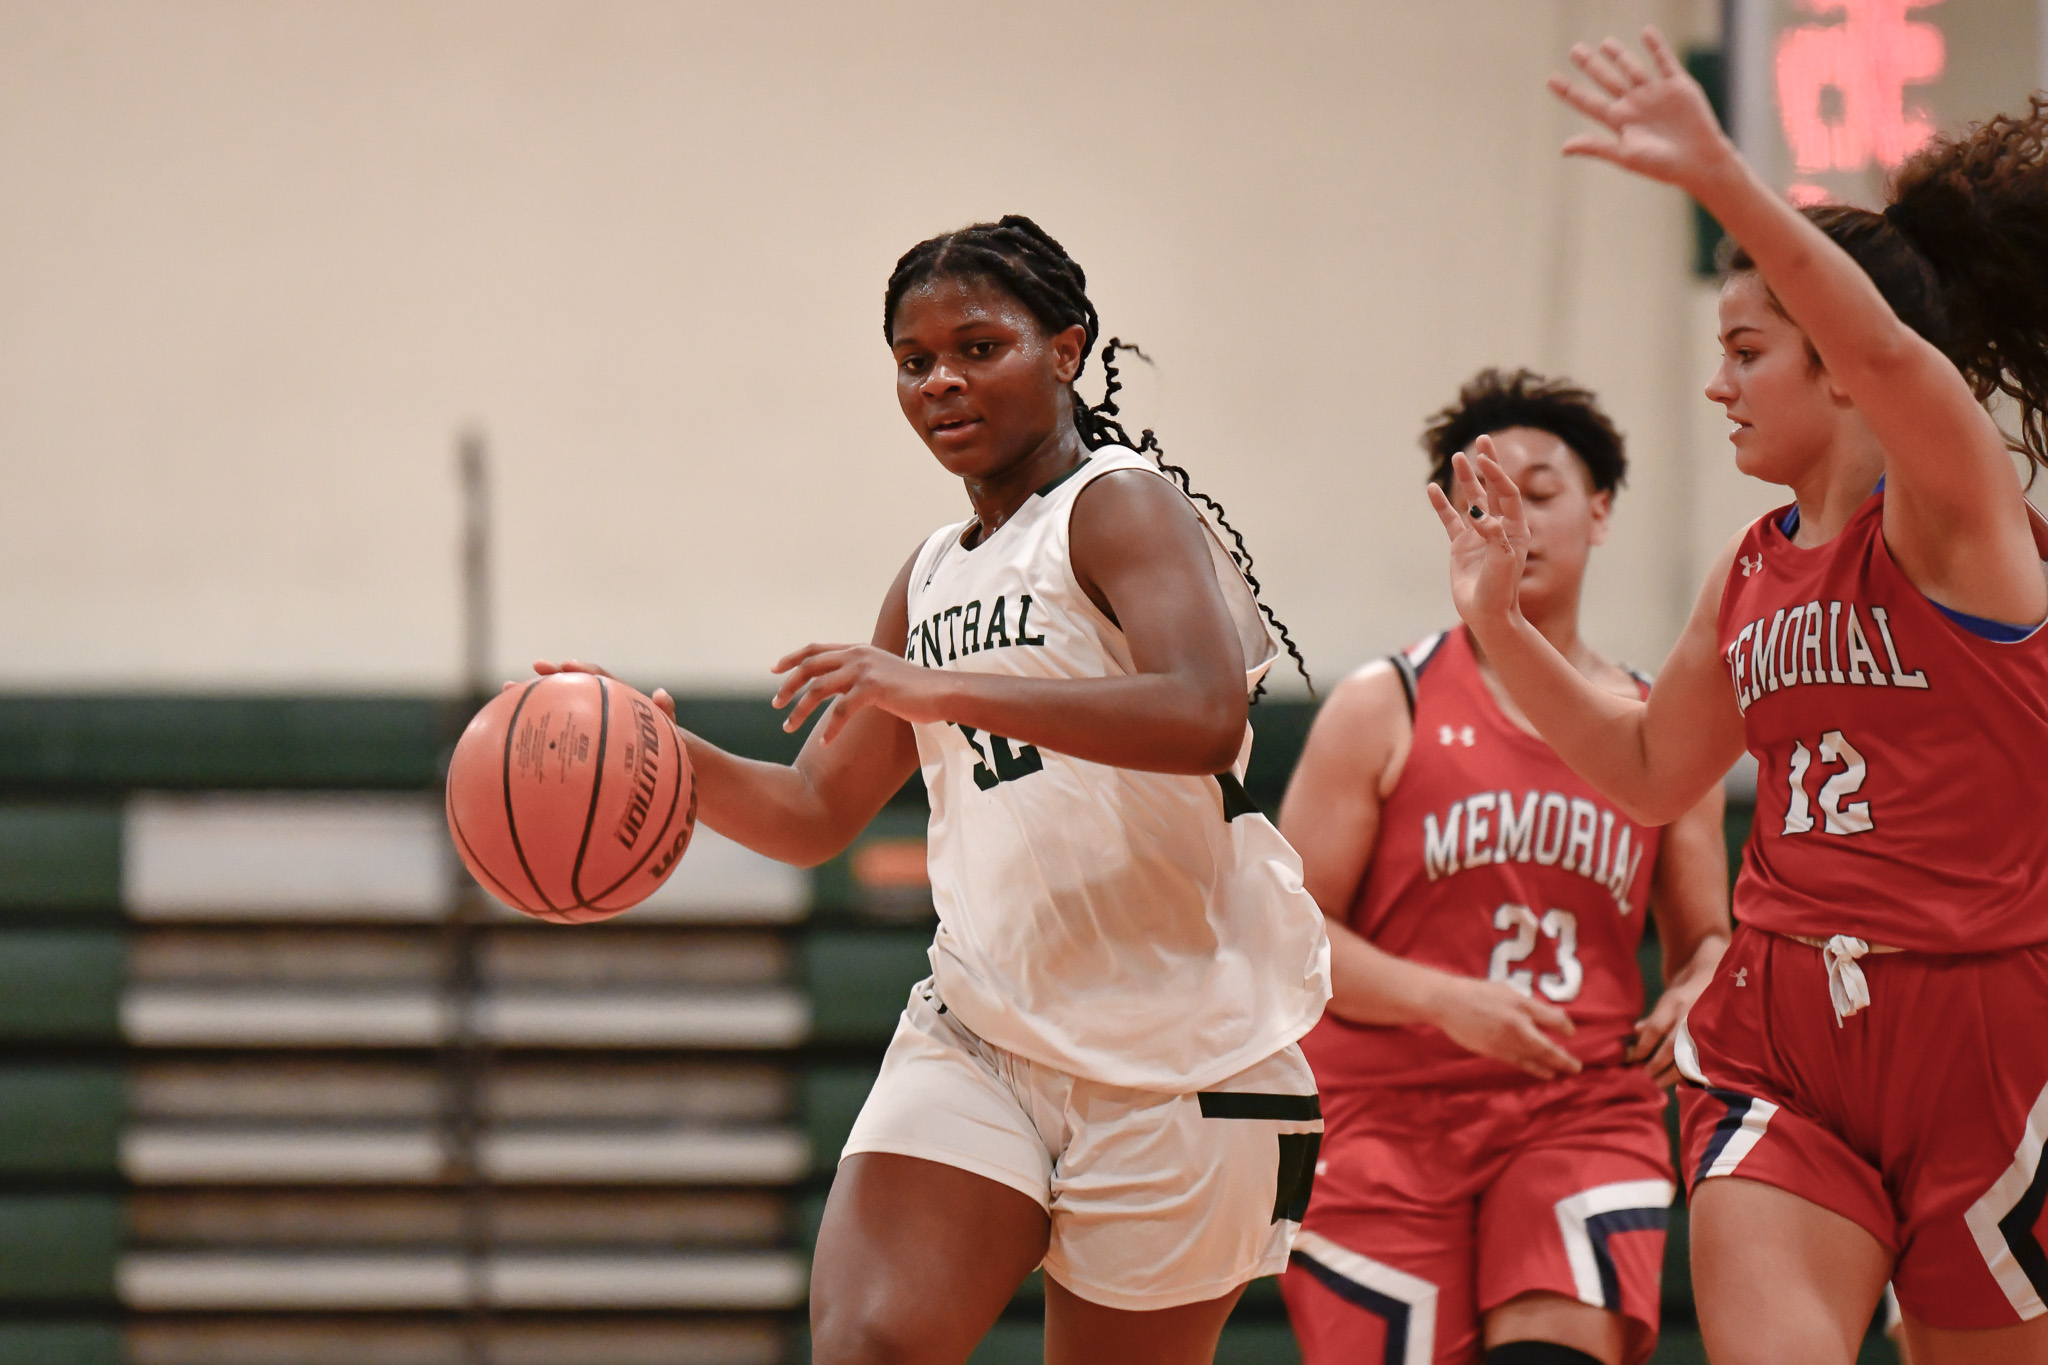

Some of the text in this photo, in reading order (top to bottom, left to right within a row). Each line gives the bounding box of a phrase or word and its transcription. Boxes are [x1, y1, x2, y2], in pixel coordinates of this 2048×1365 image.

[906, 595, 1046, 669] ENTRAL
[1781, 729, 1875, 836] 12
[1487, 902, 1584, 1002] 23
